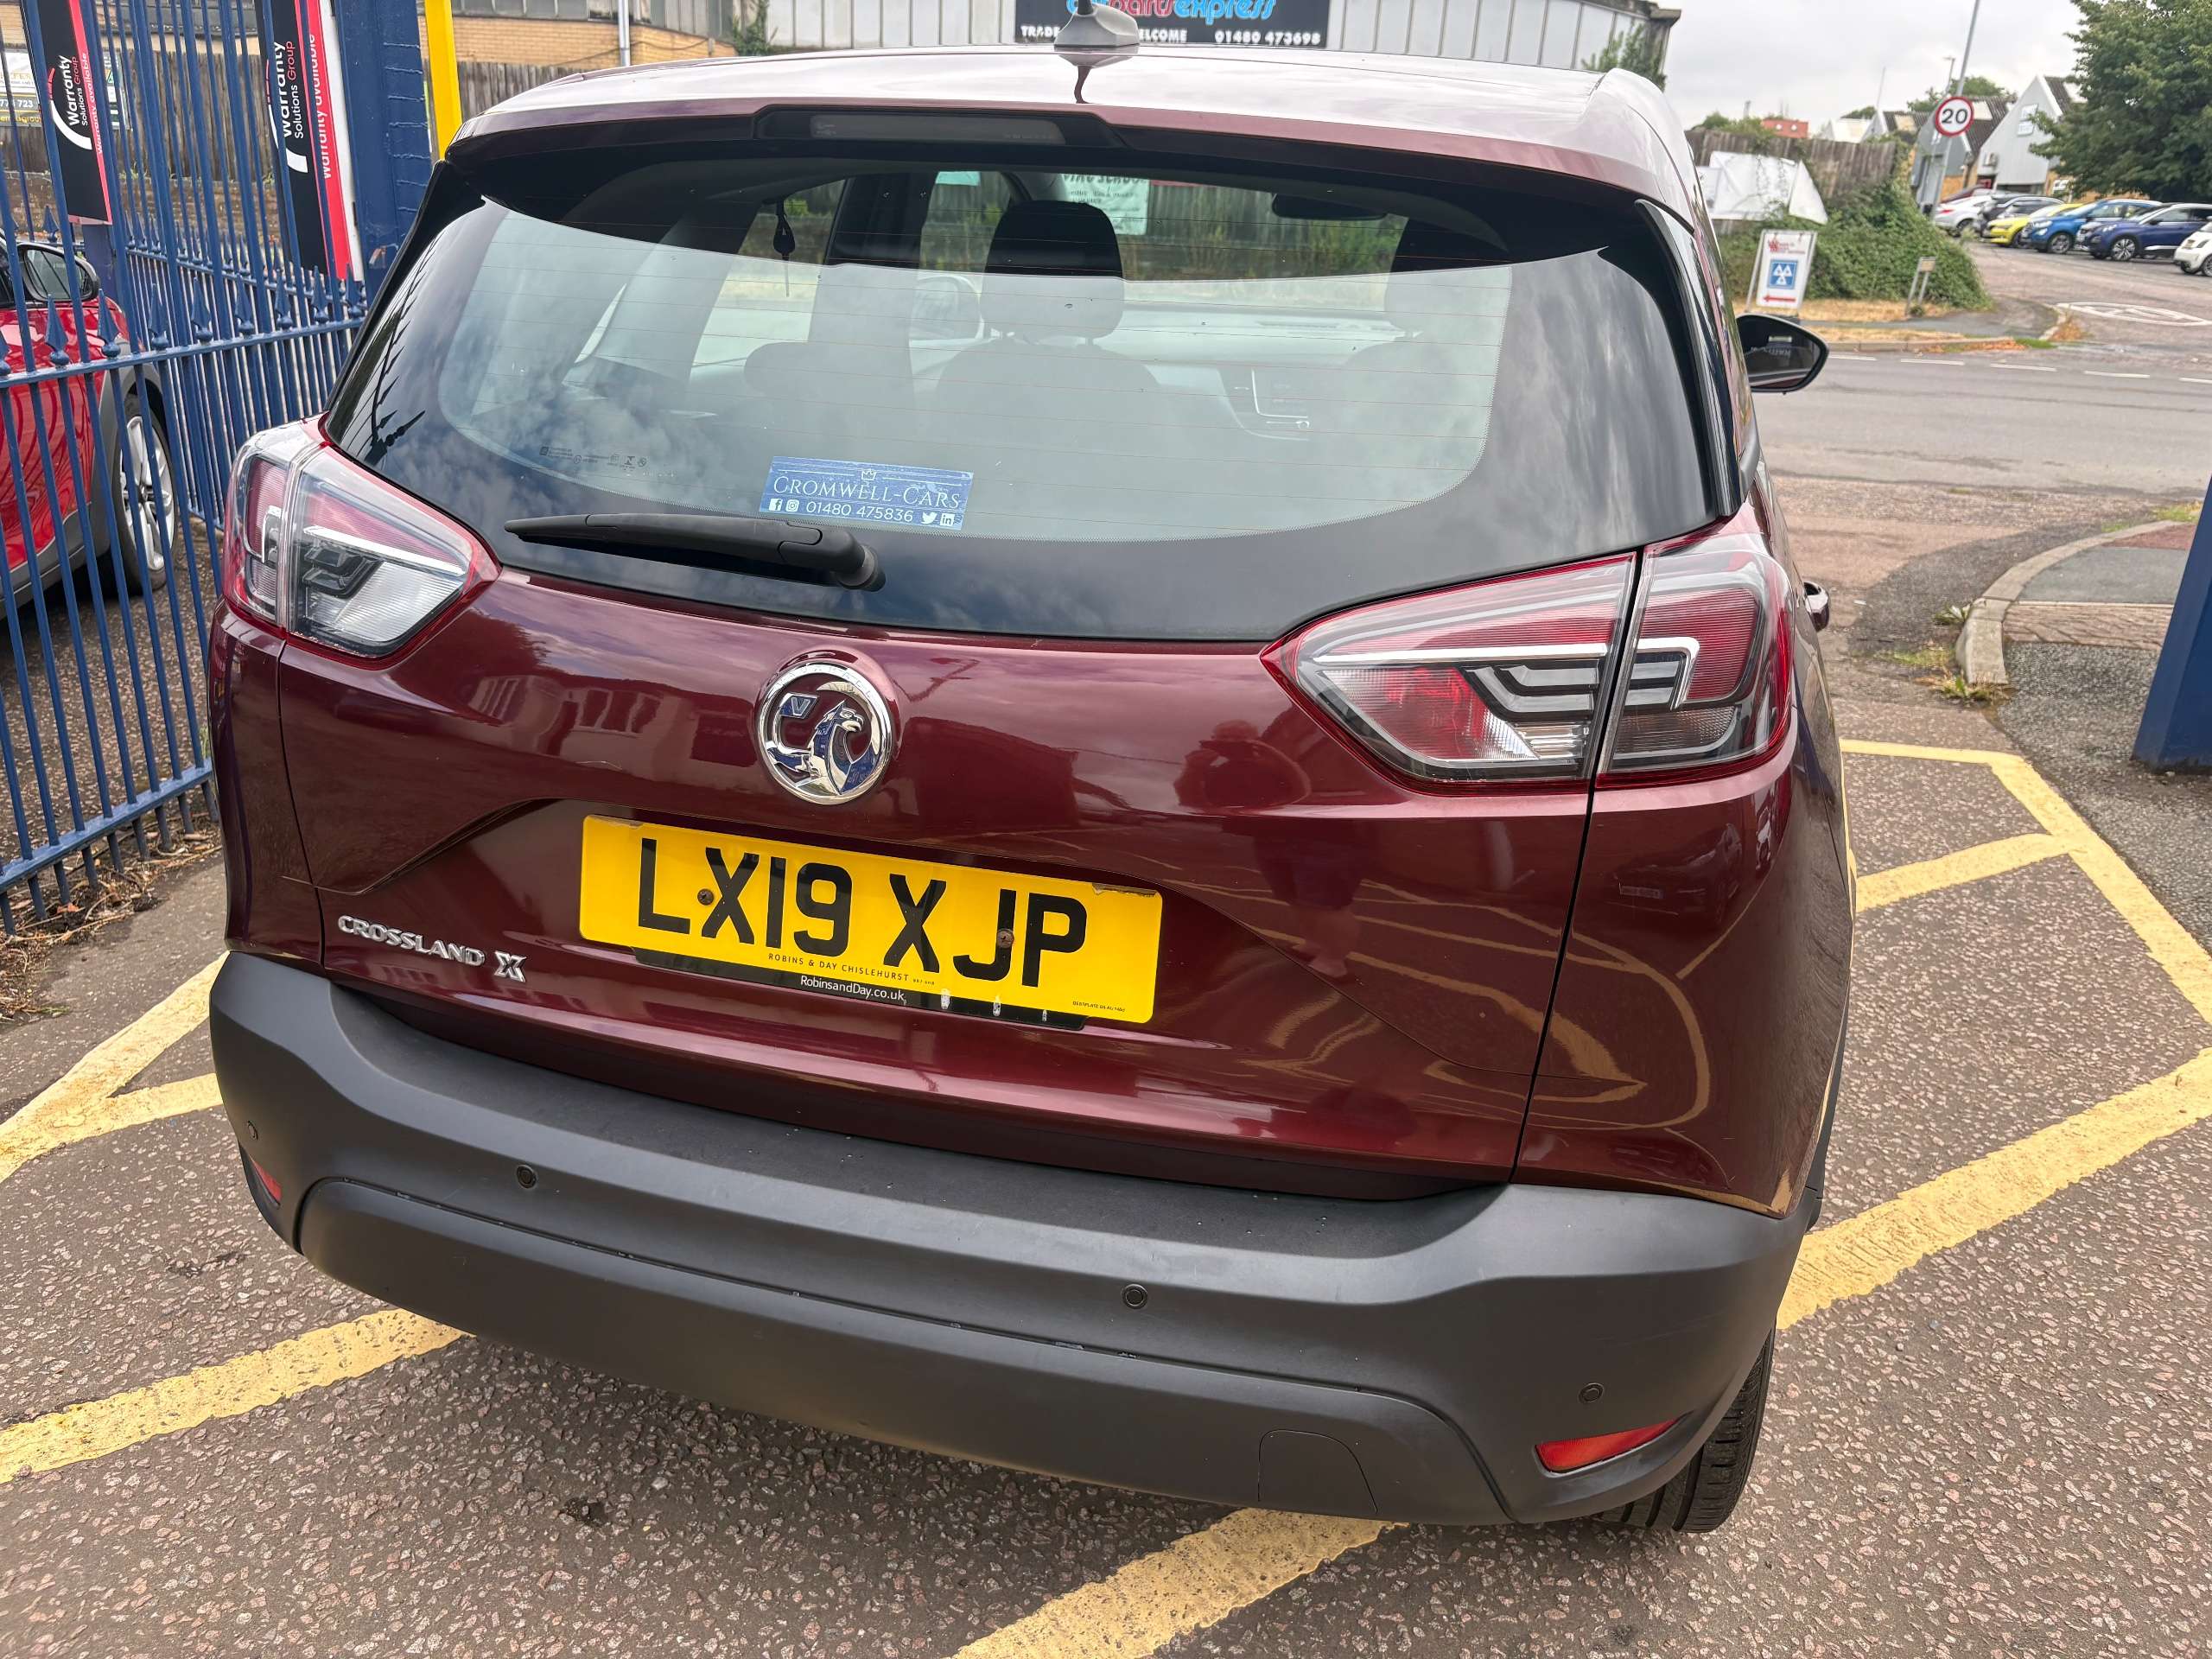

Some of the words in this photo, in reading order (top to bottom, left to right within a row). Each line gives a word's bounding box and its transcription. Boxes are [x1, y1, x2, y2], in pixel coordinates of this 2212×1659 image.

[1138, 29, 1188, 42] ELCOME
[1214, 30, 1262, 44] 01480
[72, 56, 81, 85] Group
[82, 53, 95, 103] available
[286, 41, 296, 81] Group
[59, 54, 80, 126] Warranty
[77, 87, 88, 126] Solutions
[290, 85, 304, 139] Solutions
[1941, 108, 1968, 124] 20
[805, 501, 852, 517] 01480
[856, 506, 914, 523] 475836
[638, 836, 853, 958] LX19
[883, 873, 1088, 988] XJP
[337, 914, 486, 967] CROSSLAND
[494, 950, 528, 983] X
[768, 953, 804, 966] ROBINS
[819, 960, 837, 972] DAY
[841, 963, 909, 982] CHISLEHURST
[800, 975, 906, 1002] RobinsandDay.co.uk
